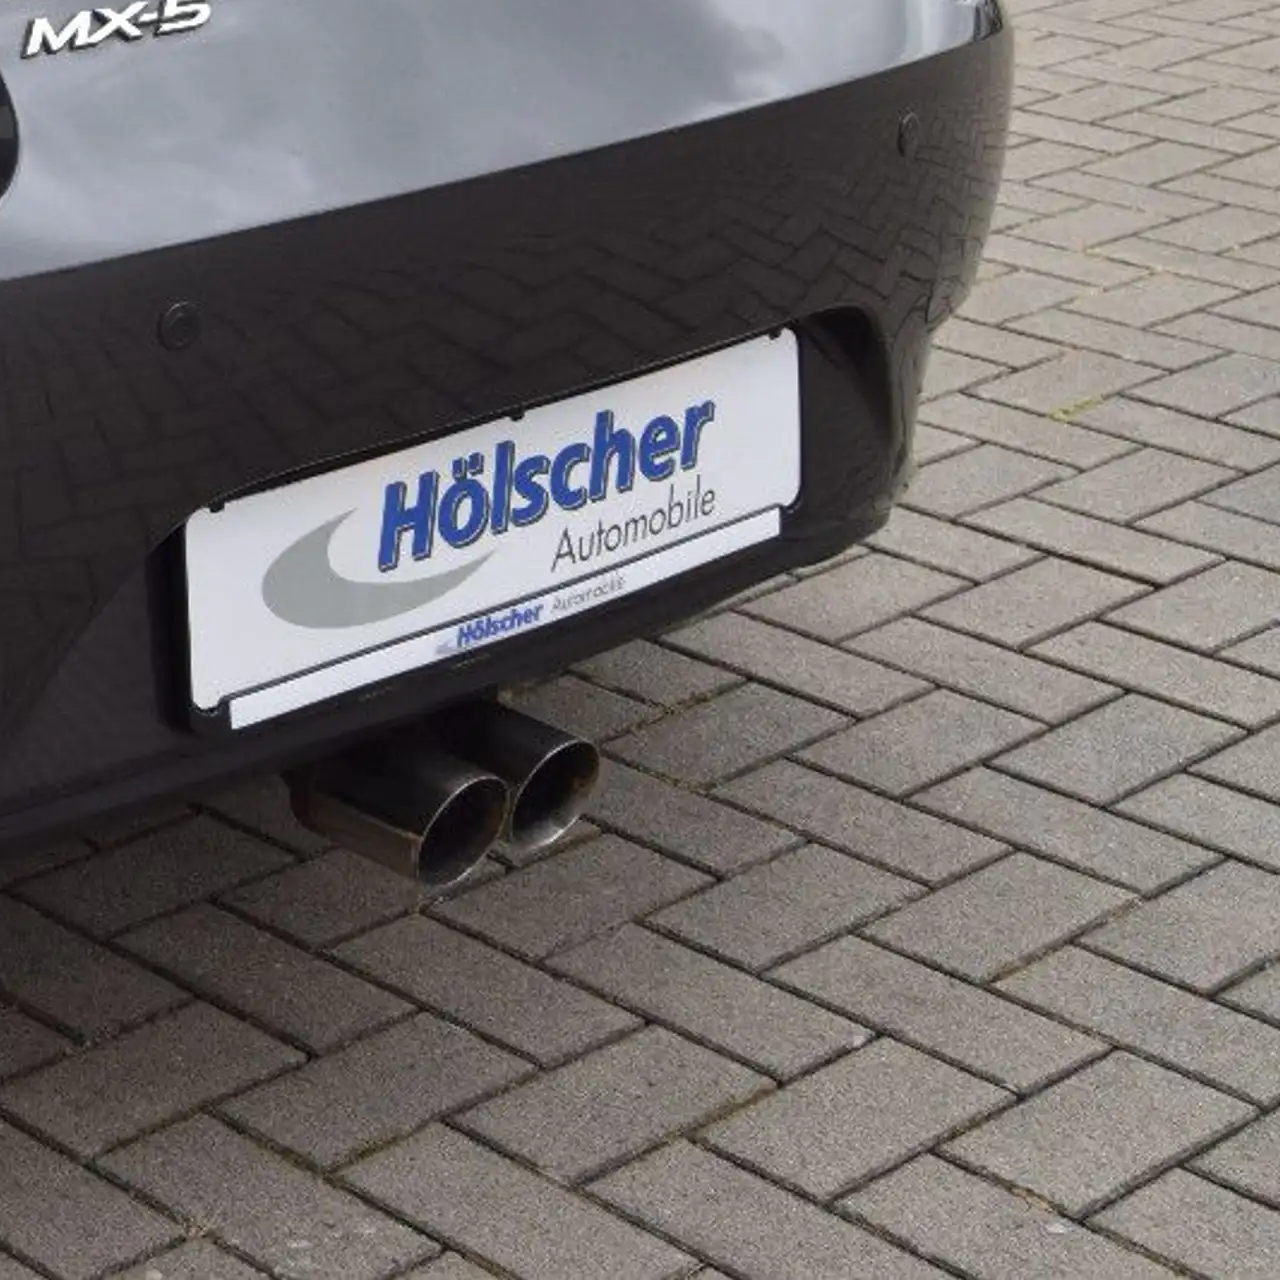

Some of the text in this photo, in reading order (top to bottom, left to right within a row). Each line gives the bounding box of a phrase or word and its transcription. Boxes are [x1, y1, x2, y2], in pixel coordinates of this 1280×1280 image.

[378, 400, 716, 573] Hölscher
[550, 474, 716, 573] Automobile
[457, 603, 545, 648] Hölscher
